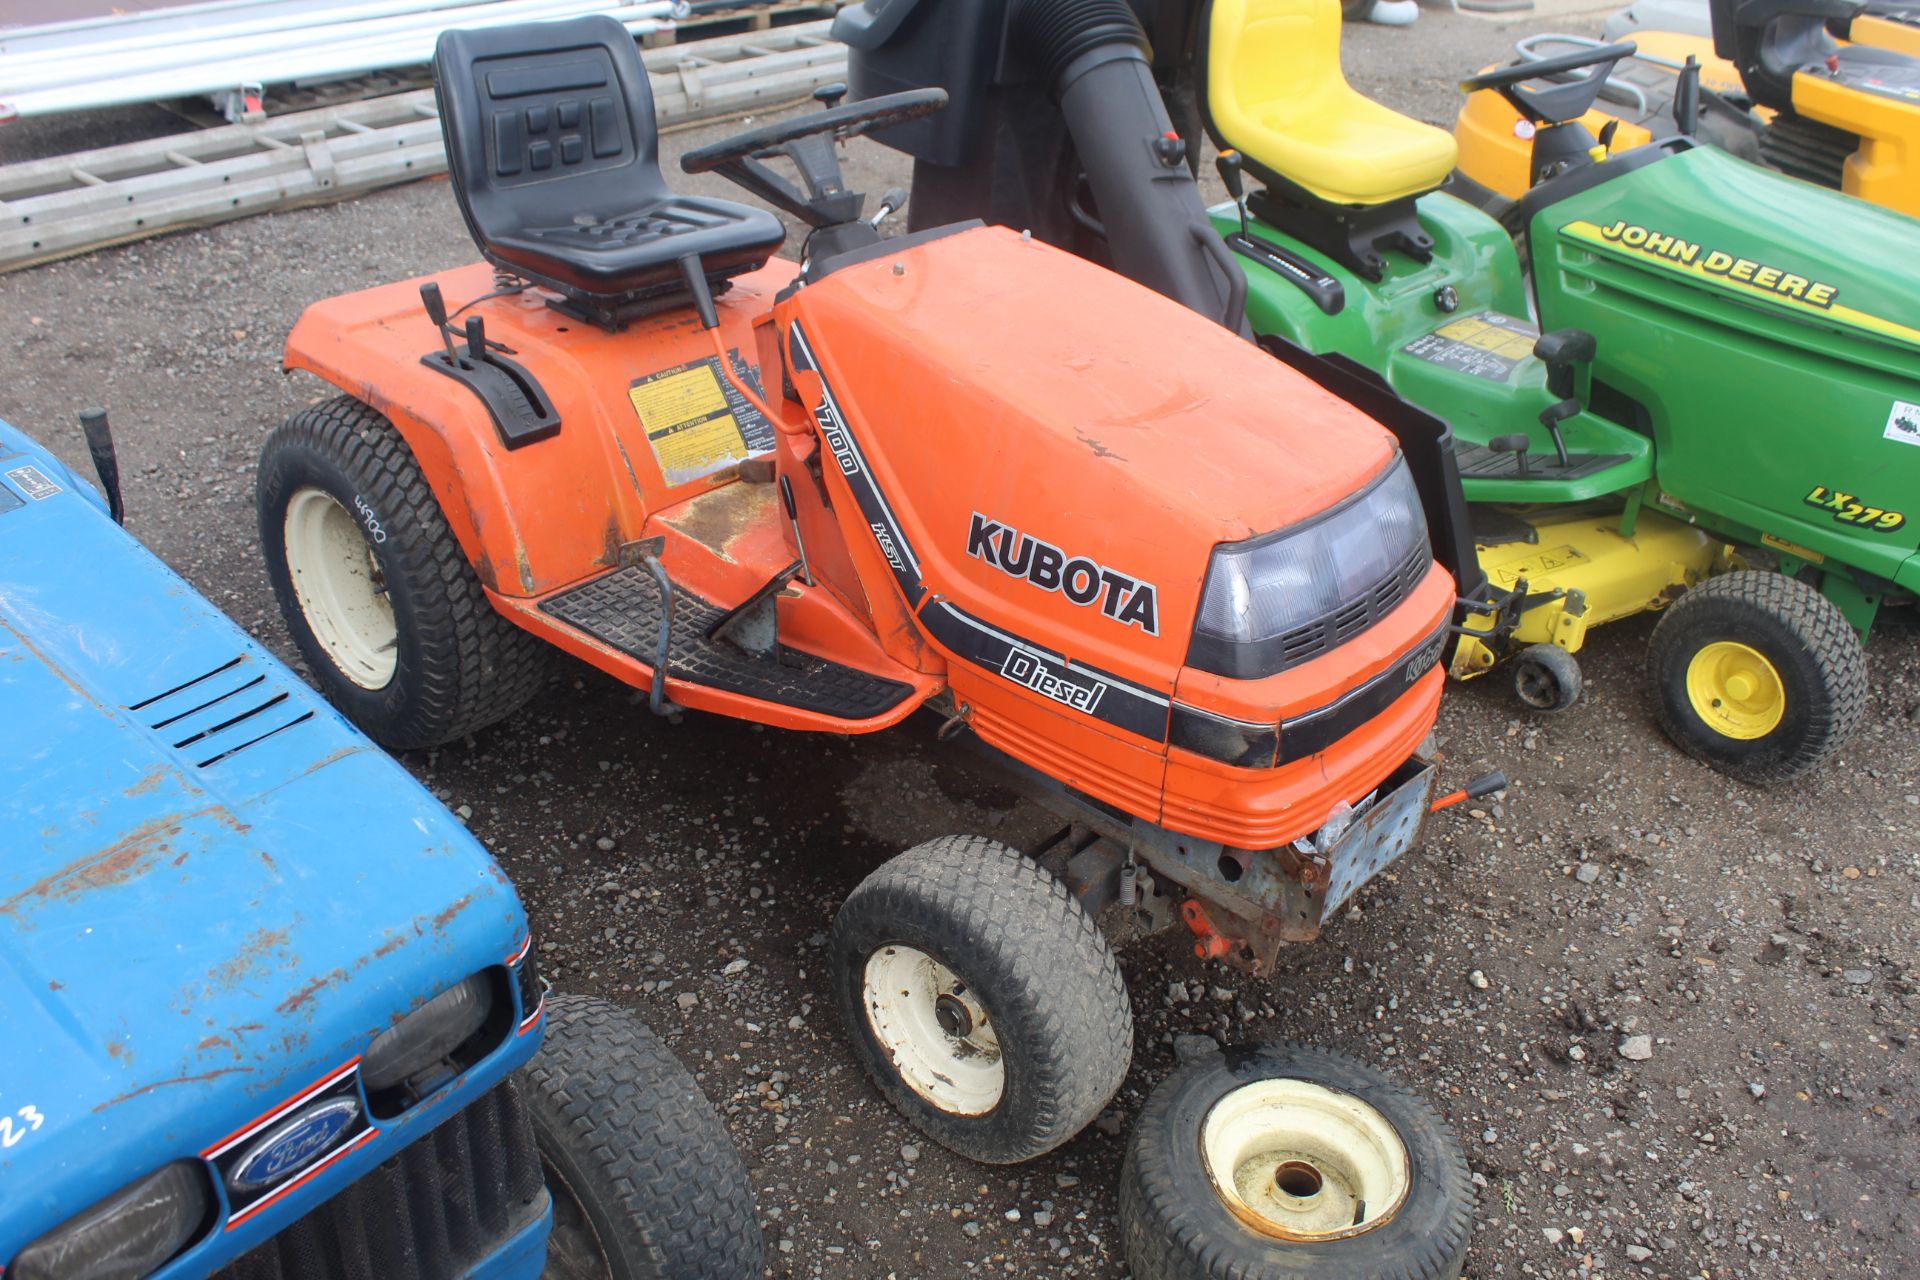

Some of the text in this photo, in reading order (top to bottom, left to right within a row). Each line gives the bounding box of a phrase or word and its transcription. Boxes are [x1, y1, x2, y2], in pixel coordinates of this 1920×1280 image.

[1601, 221, 1838, 308] JOHN DEERE
[656, 367, 682, 380] CAUTION
[677, 416, 707, 431] ATTENTION
[1803, 486, 1906, 532] LX279
[871, 522, 906, 573] HST
[967, 511, 1159, 637] KUBOTA
[1001, 647, 1107, 705] Diesel
[267, 1120, 329, 1172] Ford
